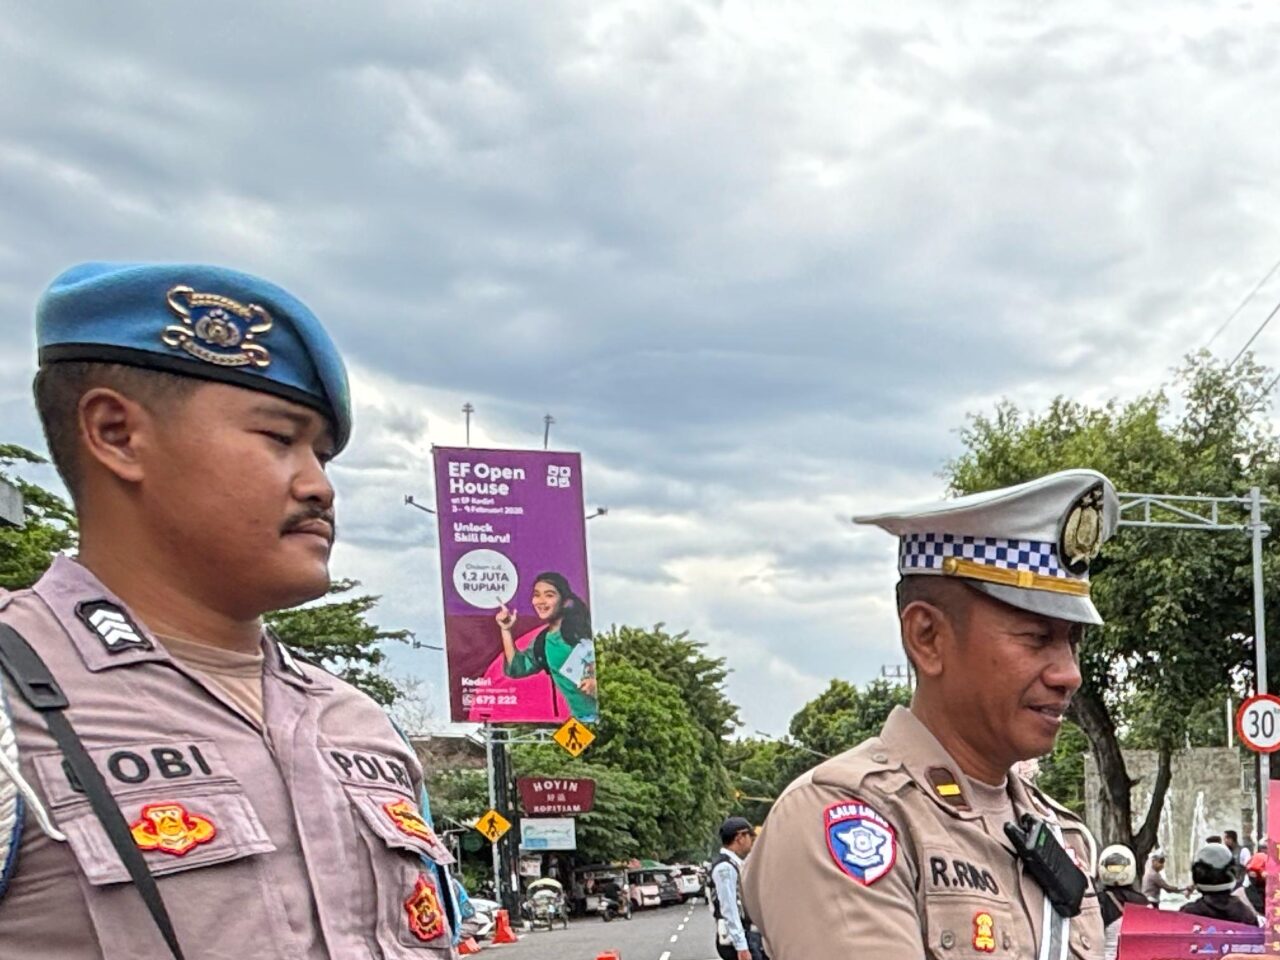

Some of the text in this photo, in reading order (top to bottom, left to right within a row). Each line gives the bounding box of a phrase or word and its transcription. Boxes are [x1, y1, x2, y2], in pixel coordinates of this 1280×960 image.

[448, 461, 526, 482] EF Open
[449, 478, 510, 496] House
[453, 522, 493, 533] Unlock
[454, 532, 479, 543] Skill
[480, 571, 510, 582] JUTA
[1248, 709, 1275, 739] 30
[532, 780, 579, 793] HOYIN
[533, 804, 581, 813] KOPITIAM
[829, 804, 857, 820] LALU
